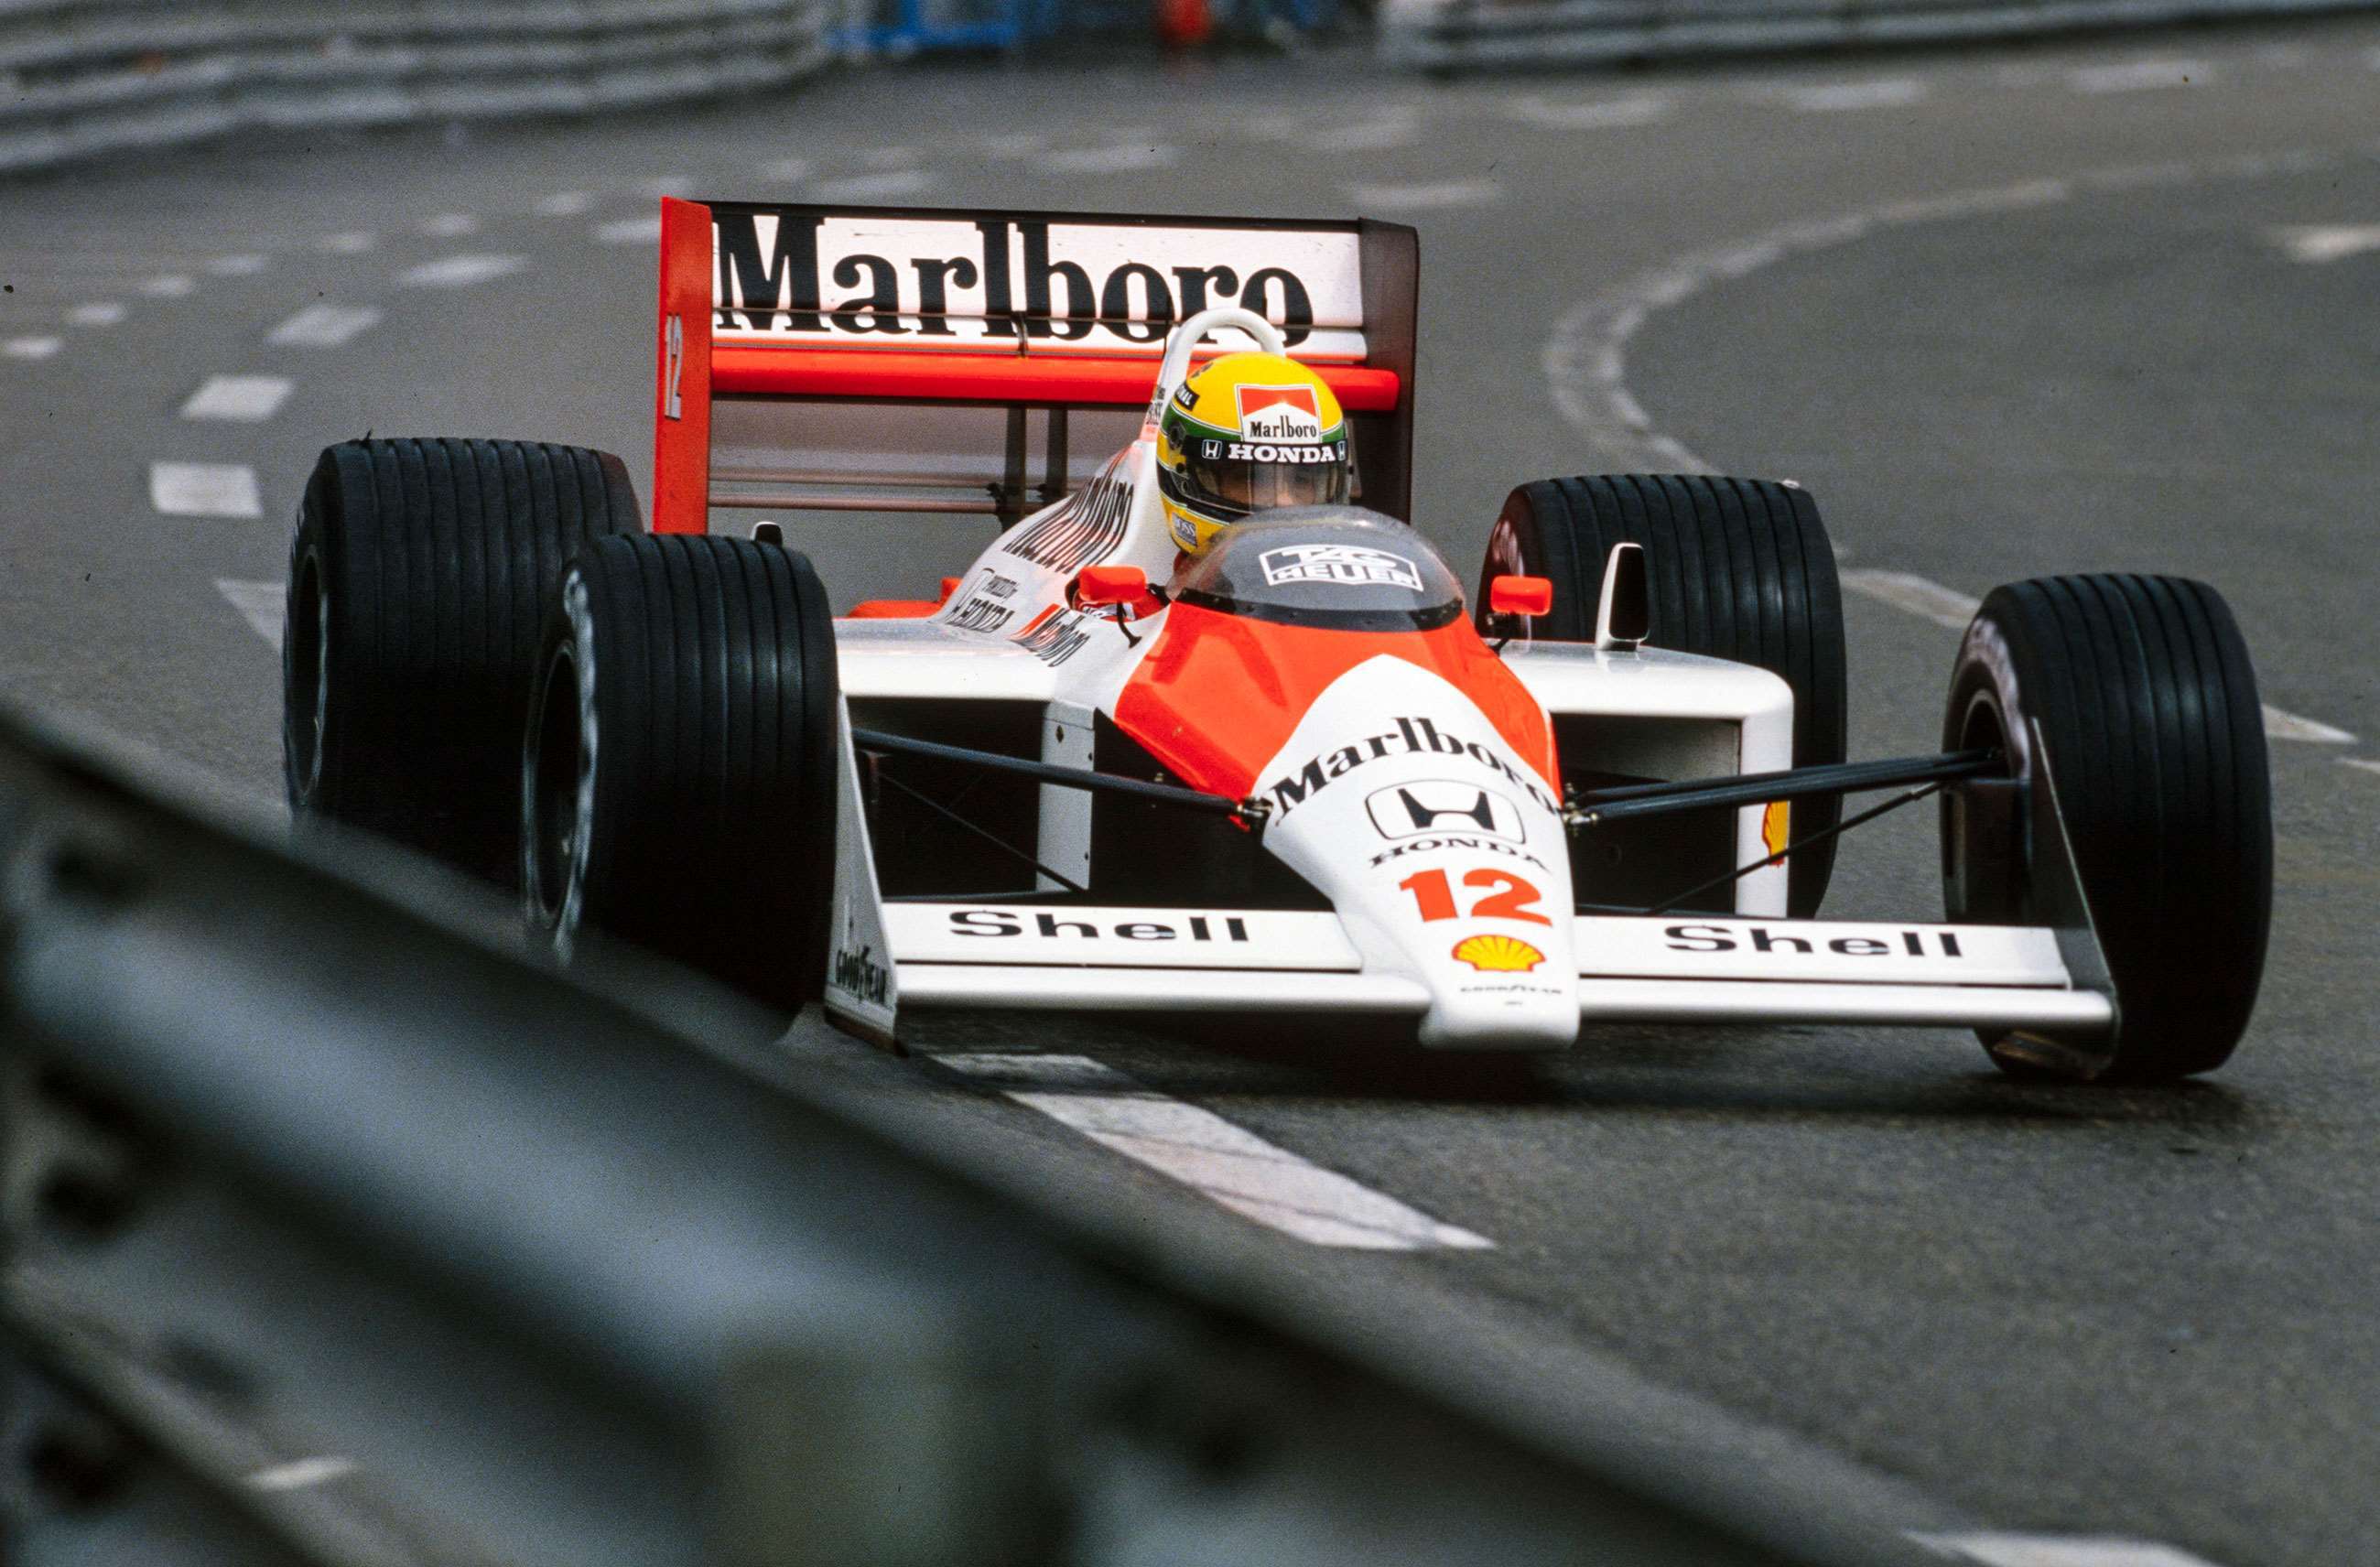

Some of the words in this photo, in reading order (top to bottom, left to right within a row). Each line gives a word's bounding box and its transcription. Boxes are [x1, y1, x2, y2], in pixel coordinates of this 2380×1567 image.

[711, 214, 1314, 348] Marlboro
[1250, 415, 1317, 438] Marlboro
[1228, 443, 1336, 464] HONDA
[1276, 563, 1416, 584] HEUER
[1270, 717, 1555, 827] Marlboro
[1369, 838, 1553, 876] HONDA
[1399, 868, 1553, 928] 12
[948, 909, 1250, 943] Shell
[1663, 924, 1963, 958] Shell
